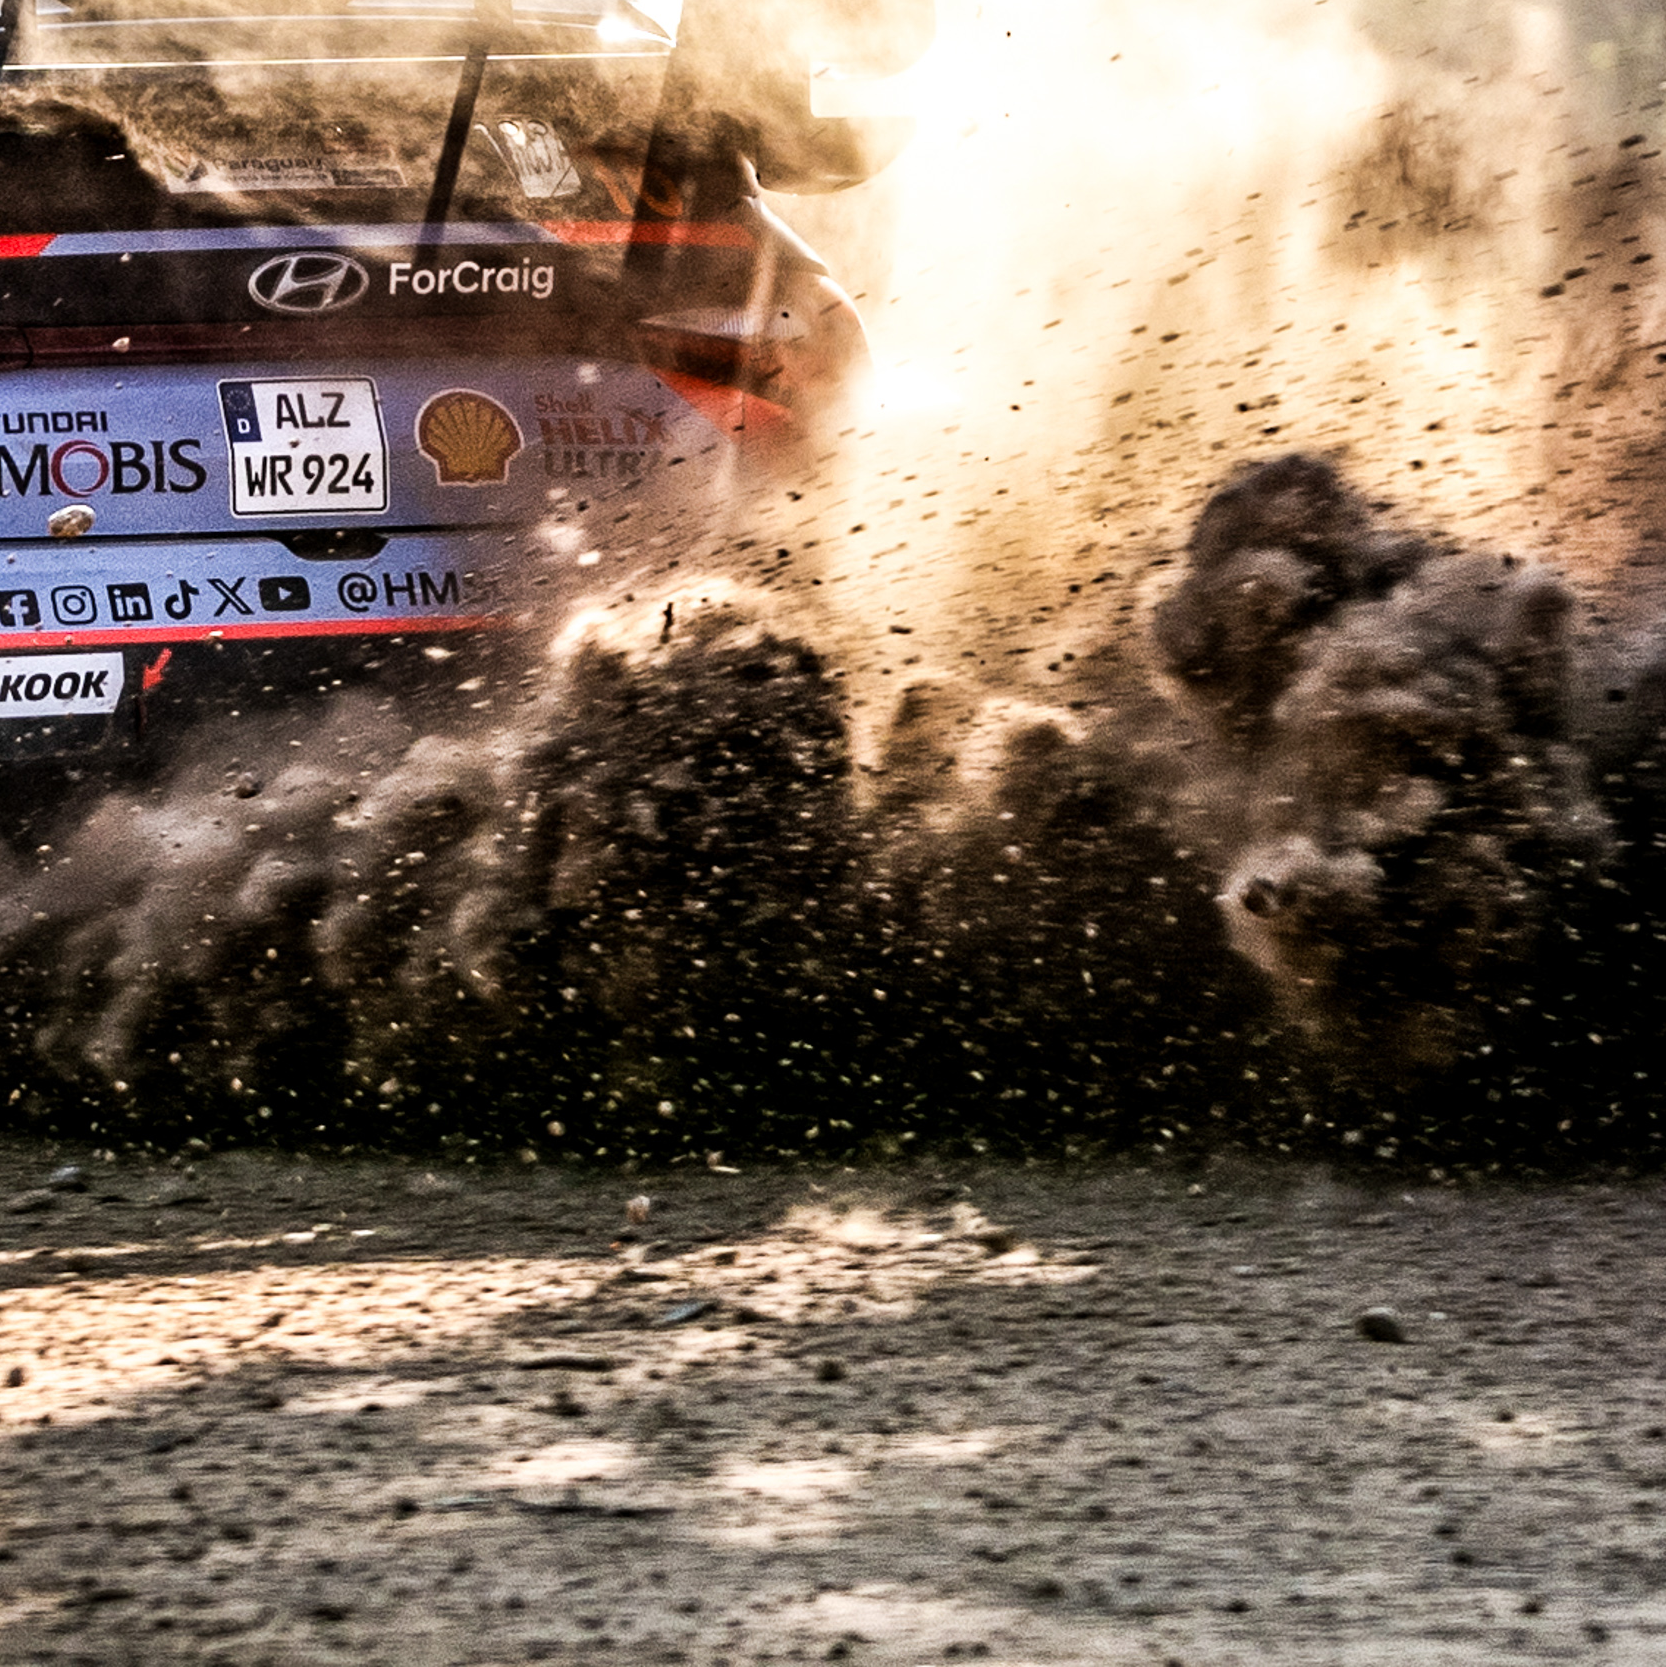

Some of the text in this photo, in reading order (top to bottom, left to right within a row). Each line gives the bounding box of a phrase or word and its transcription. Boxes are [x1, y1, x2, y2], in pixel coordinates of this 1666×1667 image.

[388, 256, 555, 300] ForCraig
[276, 392, 351, 430] ALZ
[534, 392, 594, 414] Shell
[236, 418, 251, 434] D
[537, 412, 669, 446] HELIX
[244, 452, 375, 497] WR 924
[337, 570, 464, 613] @HM
